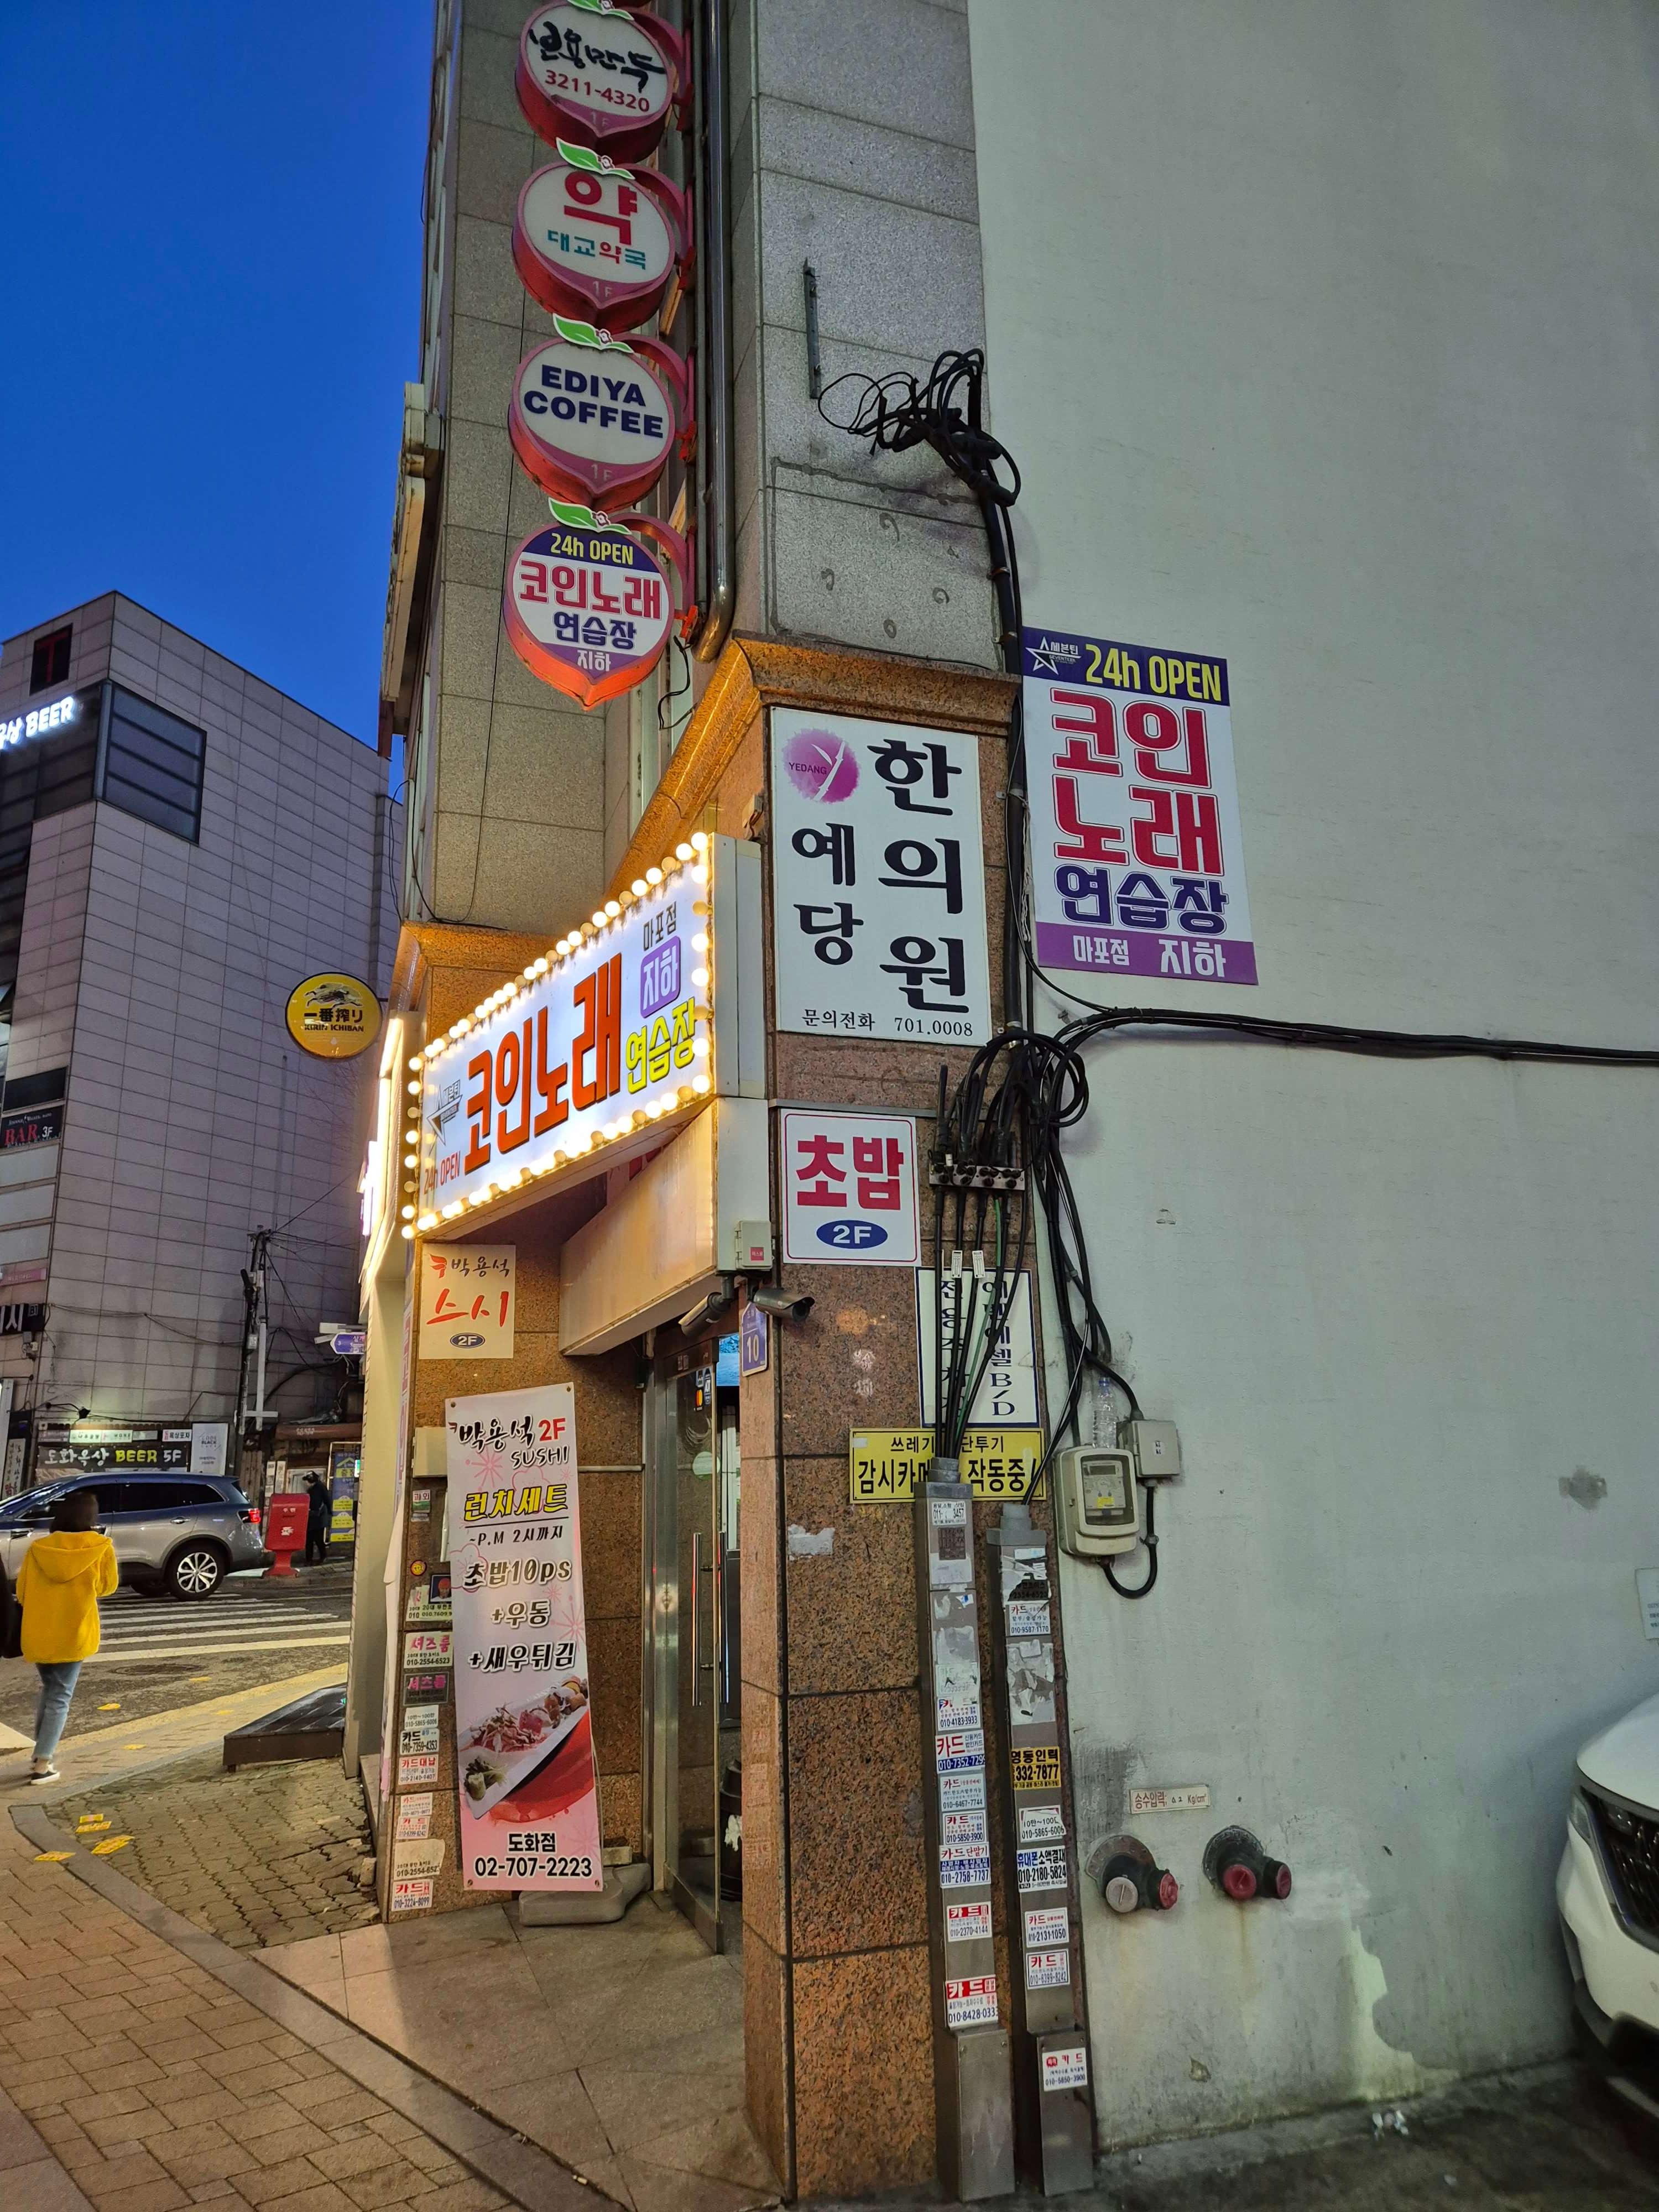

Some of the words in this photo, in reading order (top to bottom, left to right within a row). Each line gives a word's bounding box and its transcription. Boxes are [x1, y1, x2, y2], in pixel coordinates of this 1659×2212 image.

[545, 70, 650, 112] 3211-4320
[564, 171, 637, 245] 약
[547, 229, 646, 270] 대교약국
[541, 364, 646, 406] EDIYA
[523, 390, 664, 439] COFFEE
[551, 533, 584, 556] 24h
[589, 540, 633, 565] OPEN
[519, 559, 662, 620] 코인노래
[554, 611, 637, 650] 연습장
[577, 649, 611, 672] 지하
[1051, 641, 1078, 655] 세븐틴
[1085, 644, 1140, 690] 24h
[1149, 656, 1223, 702] OPEN
[26, 696, 74, 738] BEER
[1051, 687, 1212, 789] 코인
[789, 762, 827, 775] YEDANG
[1052, 775, 1225, 876] 노래
[867, 738, 969, 1013] 한의원
[791, 822, 864, 966] 예당
[1054, 863, 1229, 936] 연습장
[643, 901, 677, 951] 마포점
[1073, 934, 1130, 967] 마포점
[1159, 939, 1227, 978] 지하
[643, 949, 679, 1011] 지하
[304, 1008, 363, 1023] 一番搾り
[802, 1009, 875, 1031] 문의전화
[894, 1017, 973, 1037] 701.0008
[625, 997, 697, 1094] 연습장
[465, 952, 623, 1175] 코인노래
[4, 1124, 38, 1146] BAR
[42, 1126, 54, 1138] 3F
[423, 1167, 438, 1195] 24h
[440, 1150, 461, 1186] OPEN
[796, 1134, 904, 1211] 초밥
[832, 1224, 873, 1244] 2F
[451, 1256, 510, 1277] 박용석
[426, 1288, 509, 1328] 스시
[457, 1335, 478, 1346] 2F
[747, 1334, 760, 1363] 10
[460, 1416, 535, 1452] 박용석
[539, 1417, 567, 1442] 2F
[890, 1437, 935, 1453] 쓰레기
[959, 1436, 1004, 1453] 단투기
[115, 1449, 158, 1464] BEER
[163, 1449, 182, 1463] 5F
[512, 1446, 569, 1469] SUSHI
[858, 1458, 930, 1494] 감시카메
[464, 1483, 568, 1522] 런치세트
[513, 1525, 564, 1543] 2시까지
[464, 1557, 573, 1588] 초밥10ps
[491, 1598, 552, 1629] +우동
[1011, 1606, 1027, 1615] 카드
[467, 1639, 577, 1672] +새우튀김
[402, 1730, 421, 1743] 카드
[936, 1735, 966, 1757] 카드
[1011, 1749, 1058, 1764] 영동인력
[943, 1778, 961, 1790] 카드
[947, 1815, 969, 1825] 카드
[508, 1832, 556, 1853] 도화점
[941, 1848, 966, 1860] 카드
[474, 1856, 592, 1877] 02-707-2223
[395, 1882, 422, 1895] 카드
[950, 1906, 979, 1918] 카드
[1029, 1914, 1046, 1926] 카드
[1030, 1955, 1057, 1968] 카드
[948, 1979, 984, 1999] 카드
[948, 2007, 998, 2024] 010·8428·033
